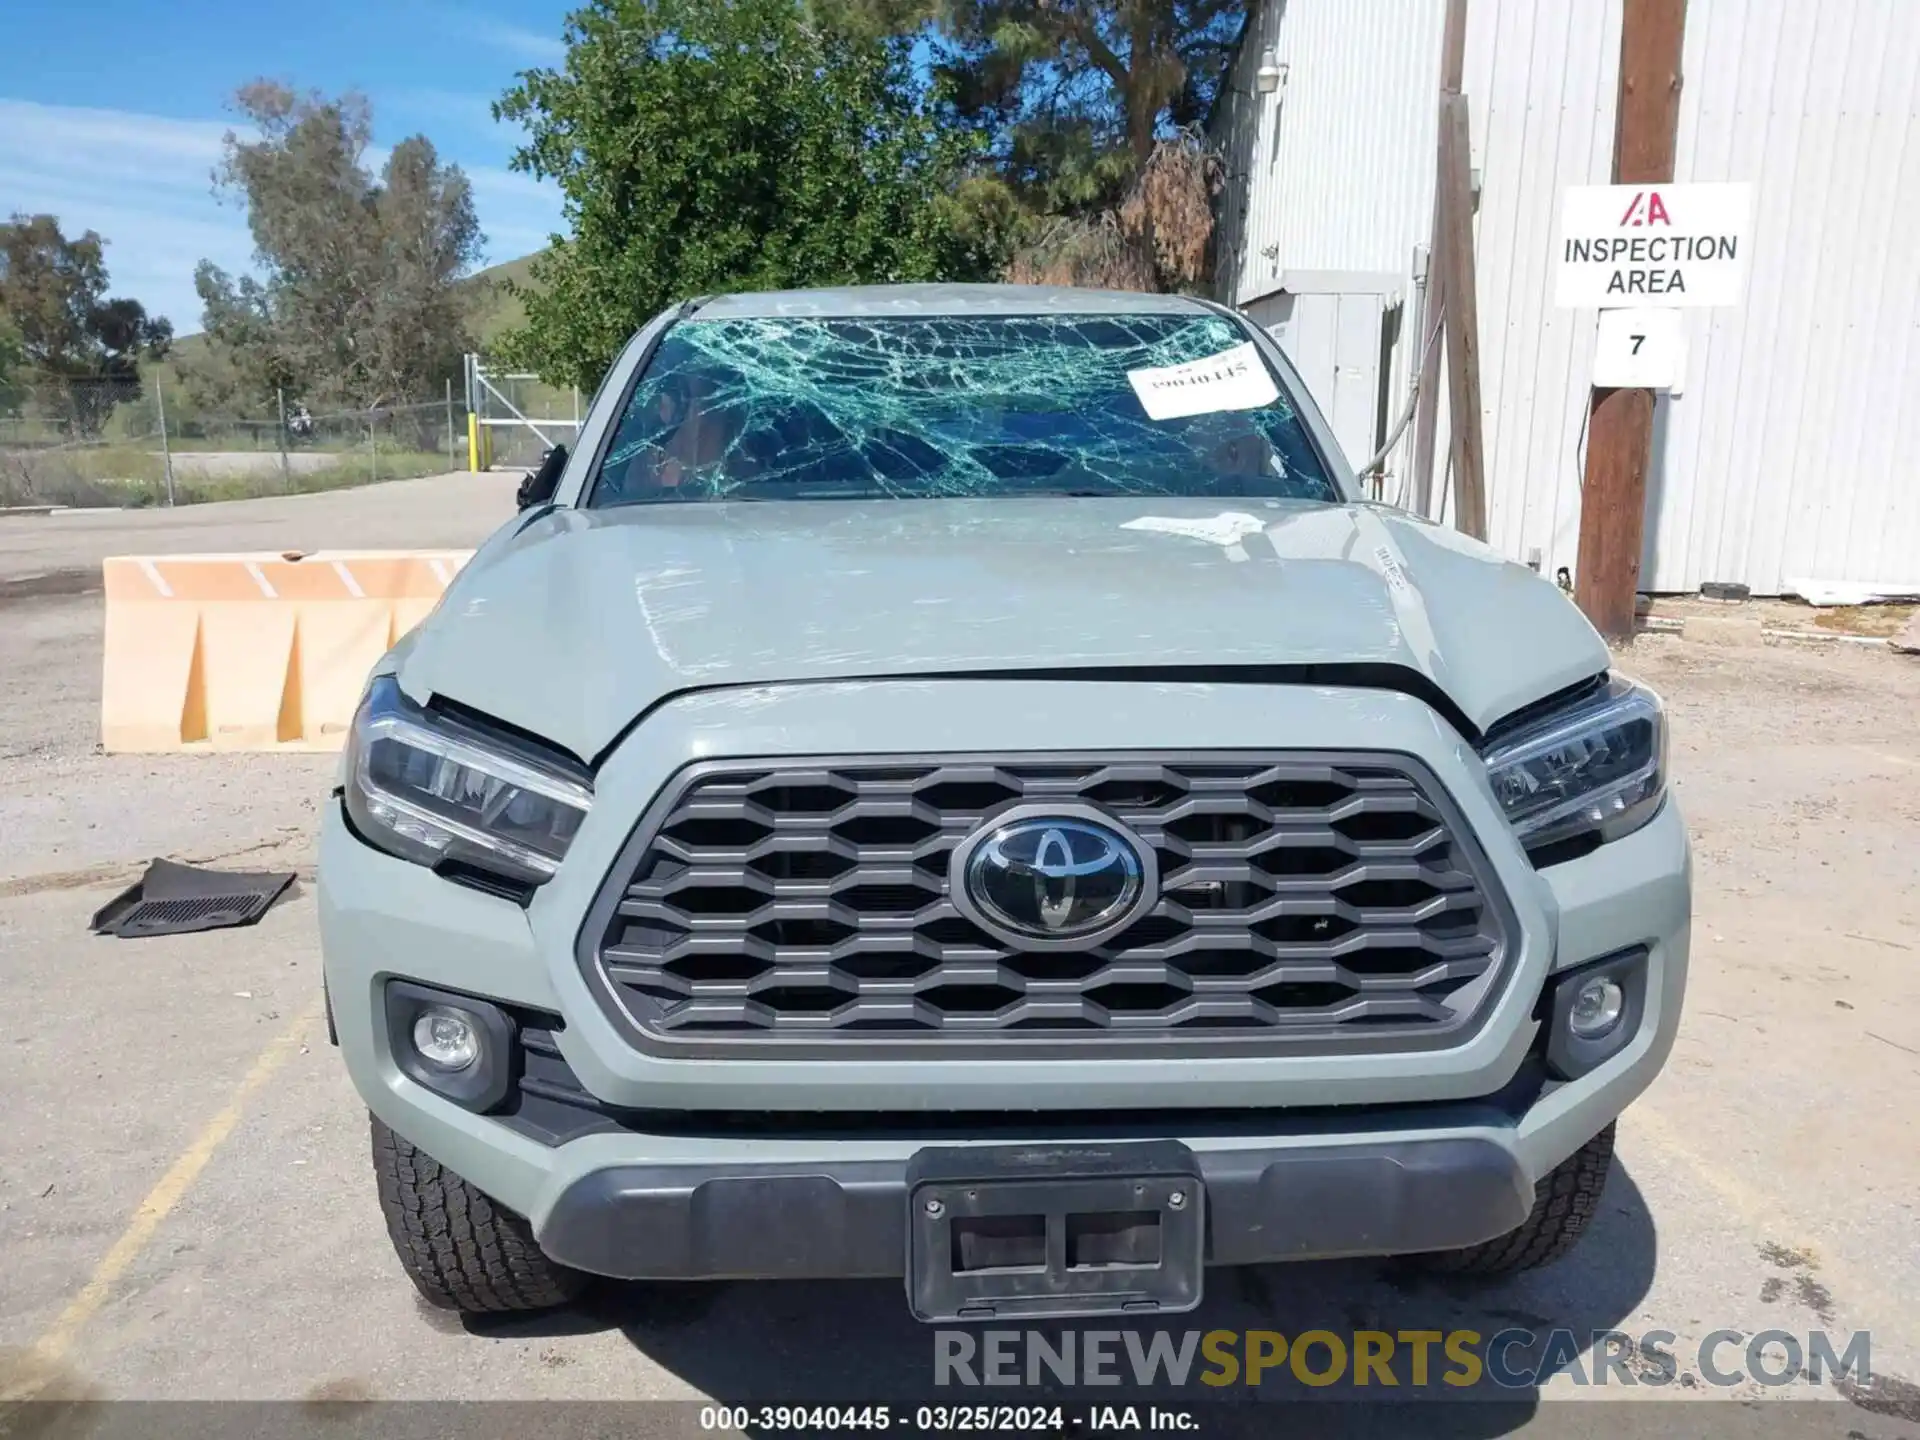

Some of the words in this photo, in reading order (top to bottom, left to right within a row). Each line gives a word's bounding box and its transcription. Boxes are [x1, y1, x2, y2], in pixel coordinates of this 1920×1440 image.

[1565, 235, 1737, 262] INSPECTION
[1606, 269, 1686, 294] AREA
[1629, 334, 1646, 355] 7
